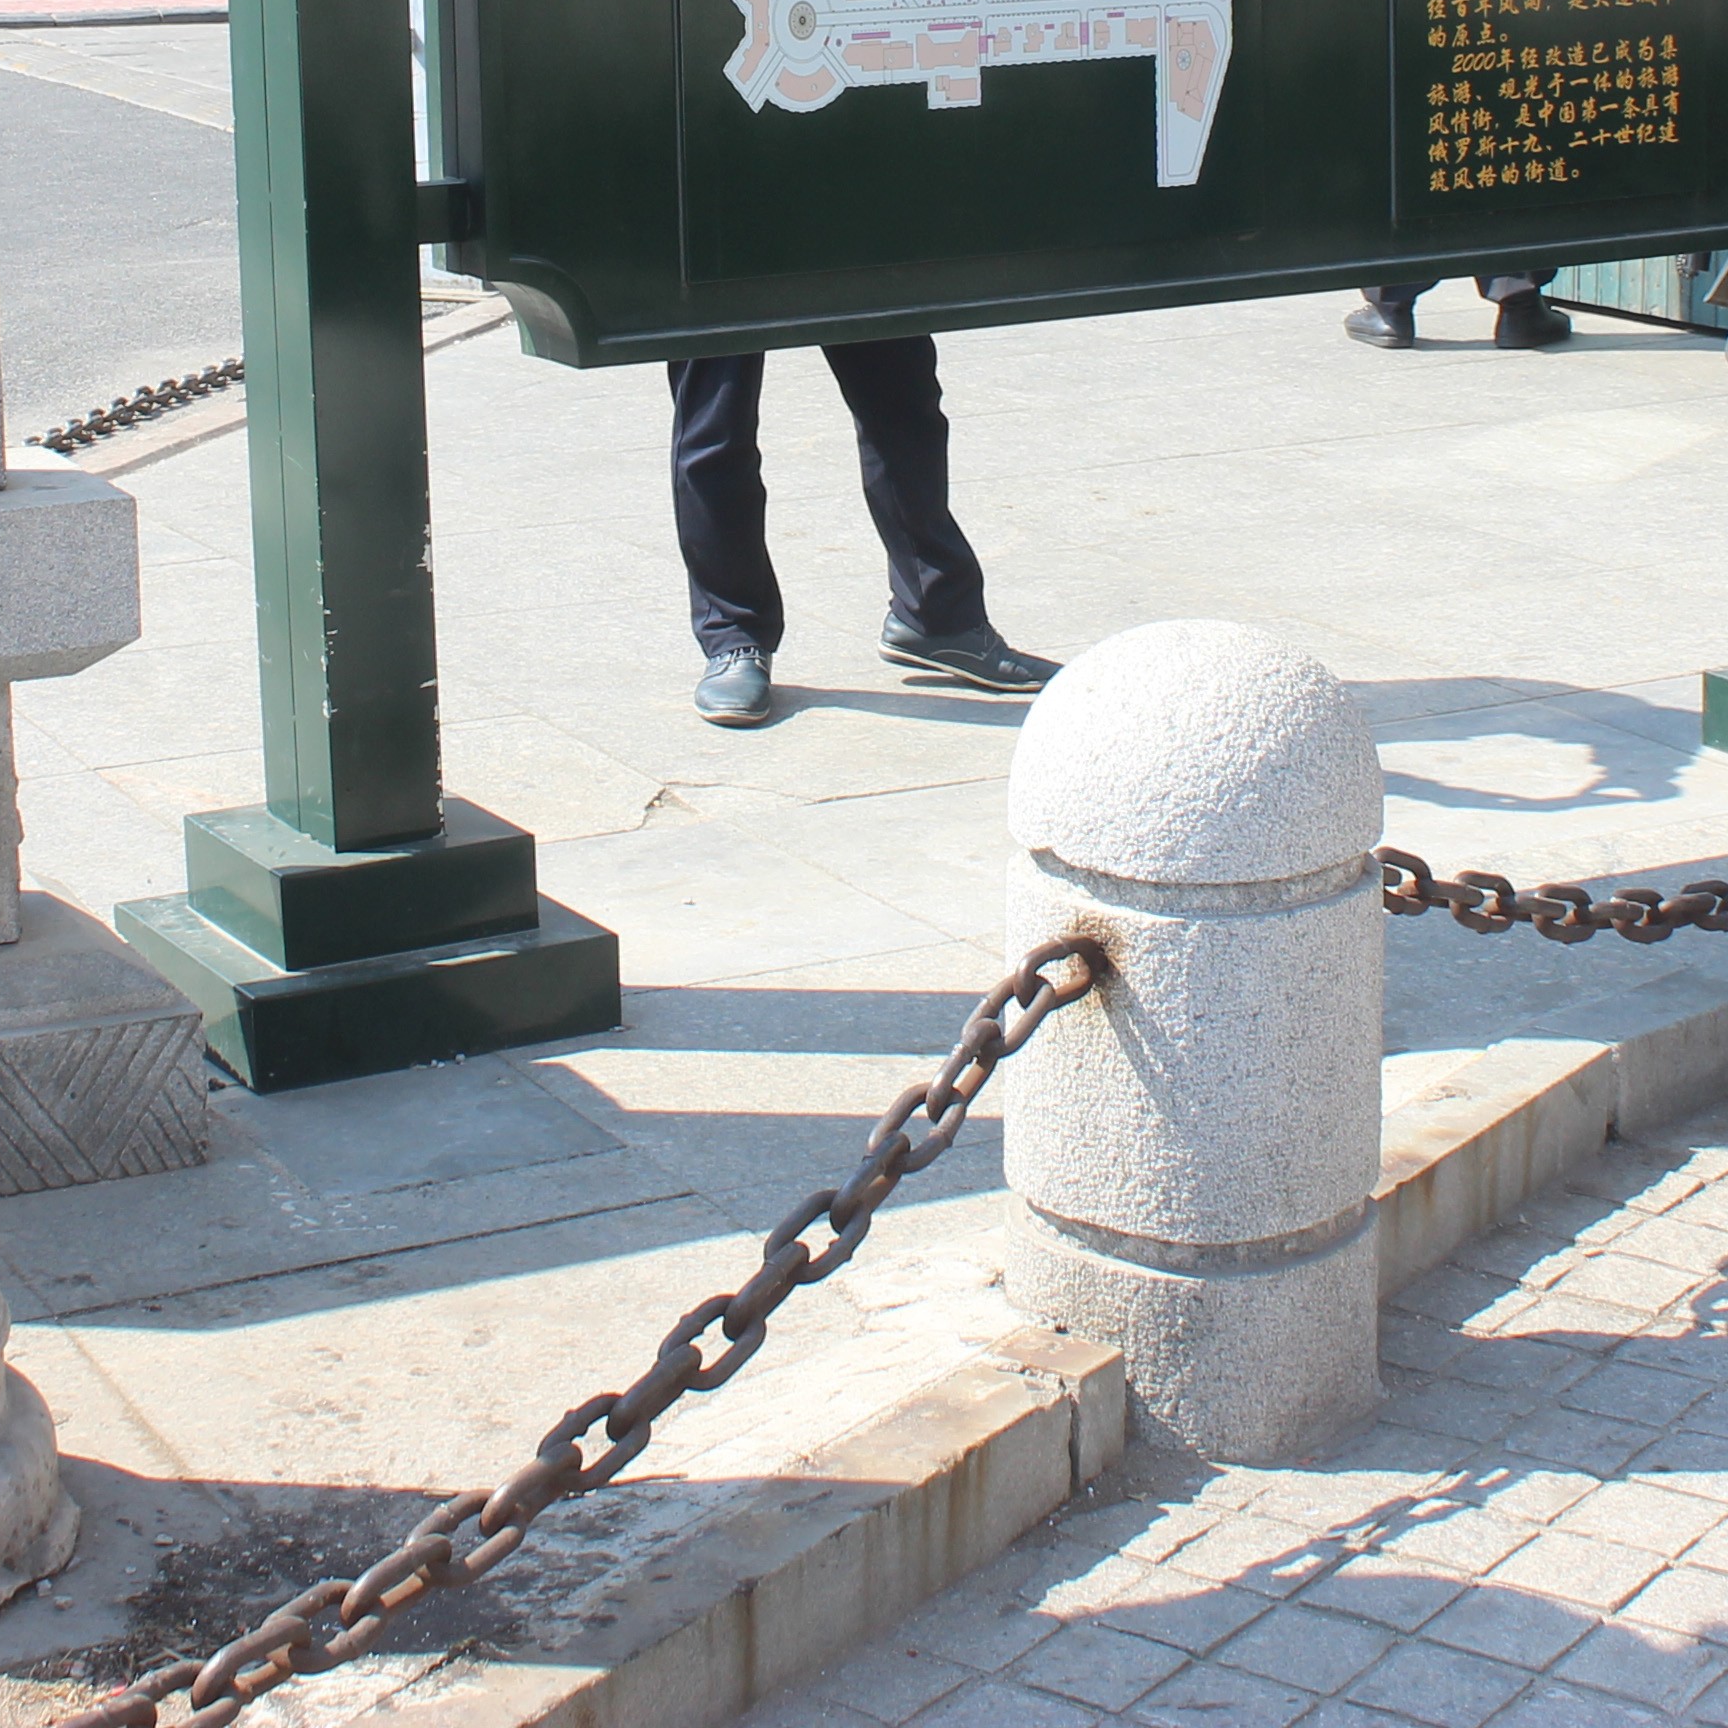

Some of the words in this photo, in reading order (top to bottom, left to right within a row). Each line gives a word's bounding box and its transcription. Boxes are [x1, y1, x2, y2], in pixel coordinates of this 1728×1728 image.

[1427, 22, 1509, 49] 的原点。
[1451, 34, 1678, 73] 2000年经改造已成为集
[1428, 157, 1581, 192] 筑风格的街道。
